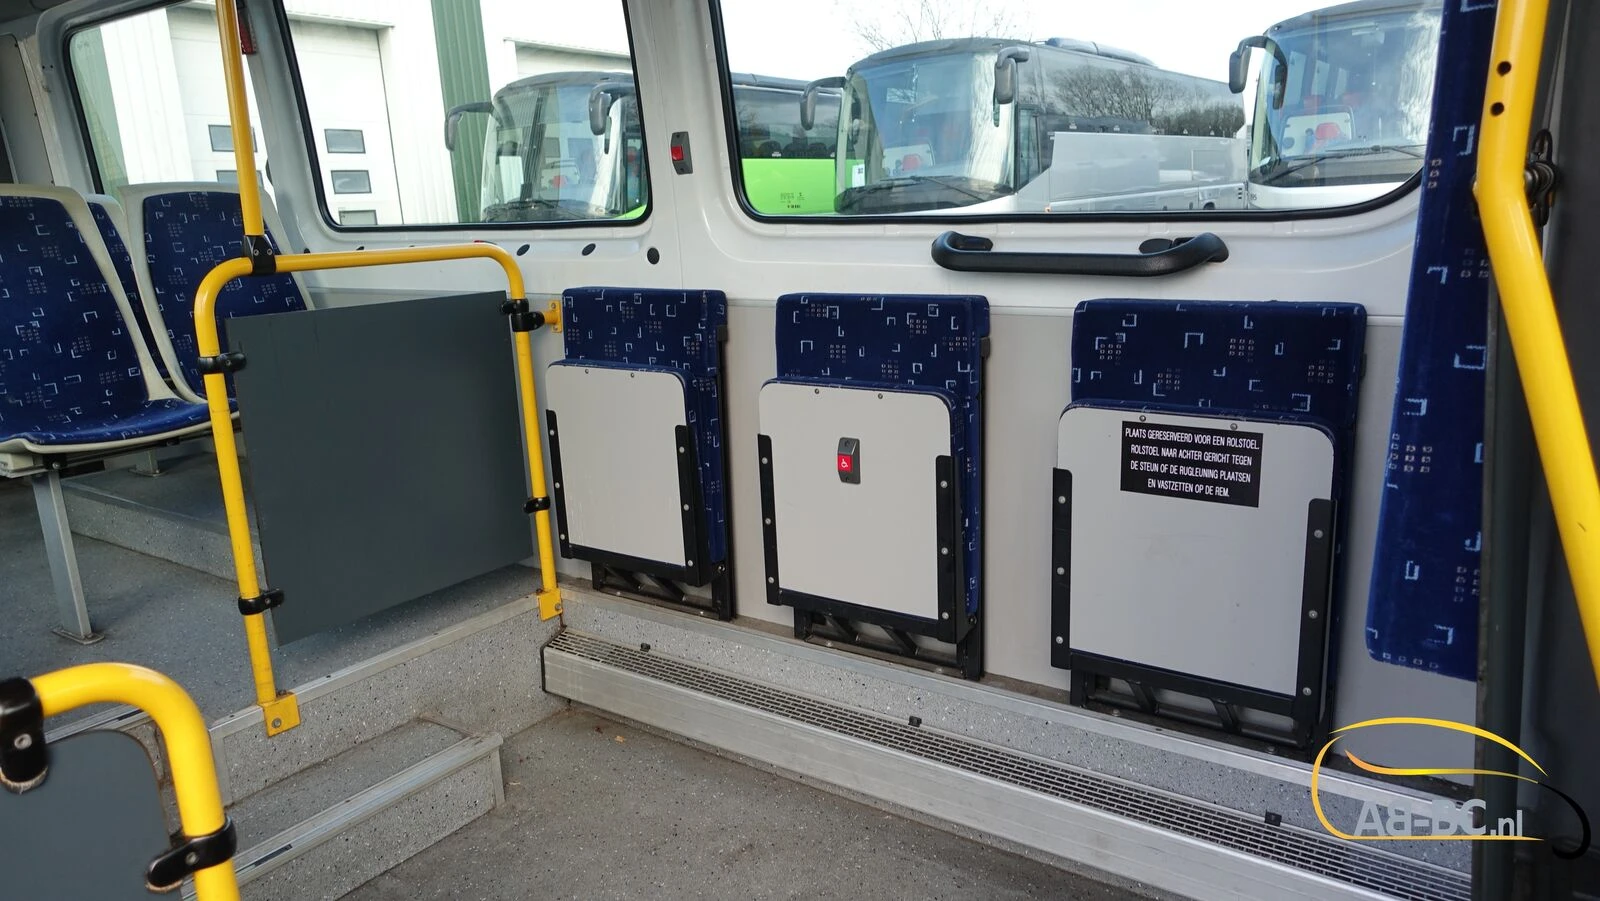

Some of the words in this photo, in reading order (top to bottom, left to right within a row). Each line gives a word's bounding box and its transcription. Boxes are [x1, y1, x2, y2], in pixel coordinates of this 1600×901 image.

[1125, 427, 1146, 439] PLAATS
[1147, 430, 1193, 443] GERESERVEERD
[1193, 434, 1211, 445] VOOR
[1212, 436, 1225, 446] EEN
[1226, 437, 1259, 450] ROLSTOEL.
[1130, 444, 1160, 457] ROLSTOEL
[1161, 447, 1177, 458] NAAR
[1178, 449, 1202, 461] ACHTER
[1203, 451, 1230, 464] GERICHT
[1231, 454, 1252, 466] TEGEN
[1130, 460, 1139, 470] DE
[1139, 461, 1159, 472] STEUN
[1160, 463, 1169, 473] OF
[1169, 464, 1178, 475] DE
[1179, 465, 1219, 480] RUGLEUNING
[1219, 470, 1251, 483] PLAATSEN
[1147, 478, 1156, 488] EN
[1157, 479, 1194, 493] VASTZETTEN
[1194, 484, 1204, 494] OP
[1205, 485, 1214, 496] DE
[1214, 486, 1230, 497] REM.
